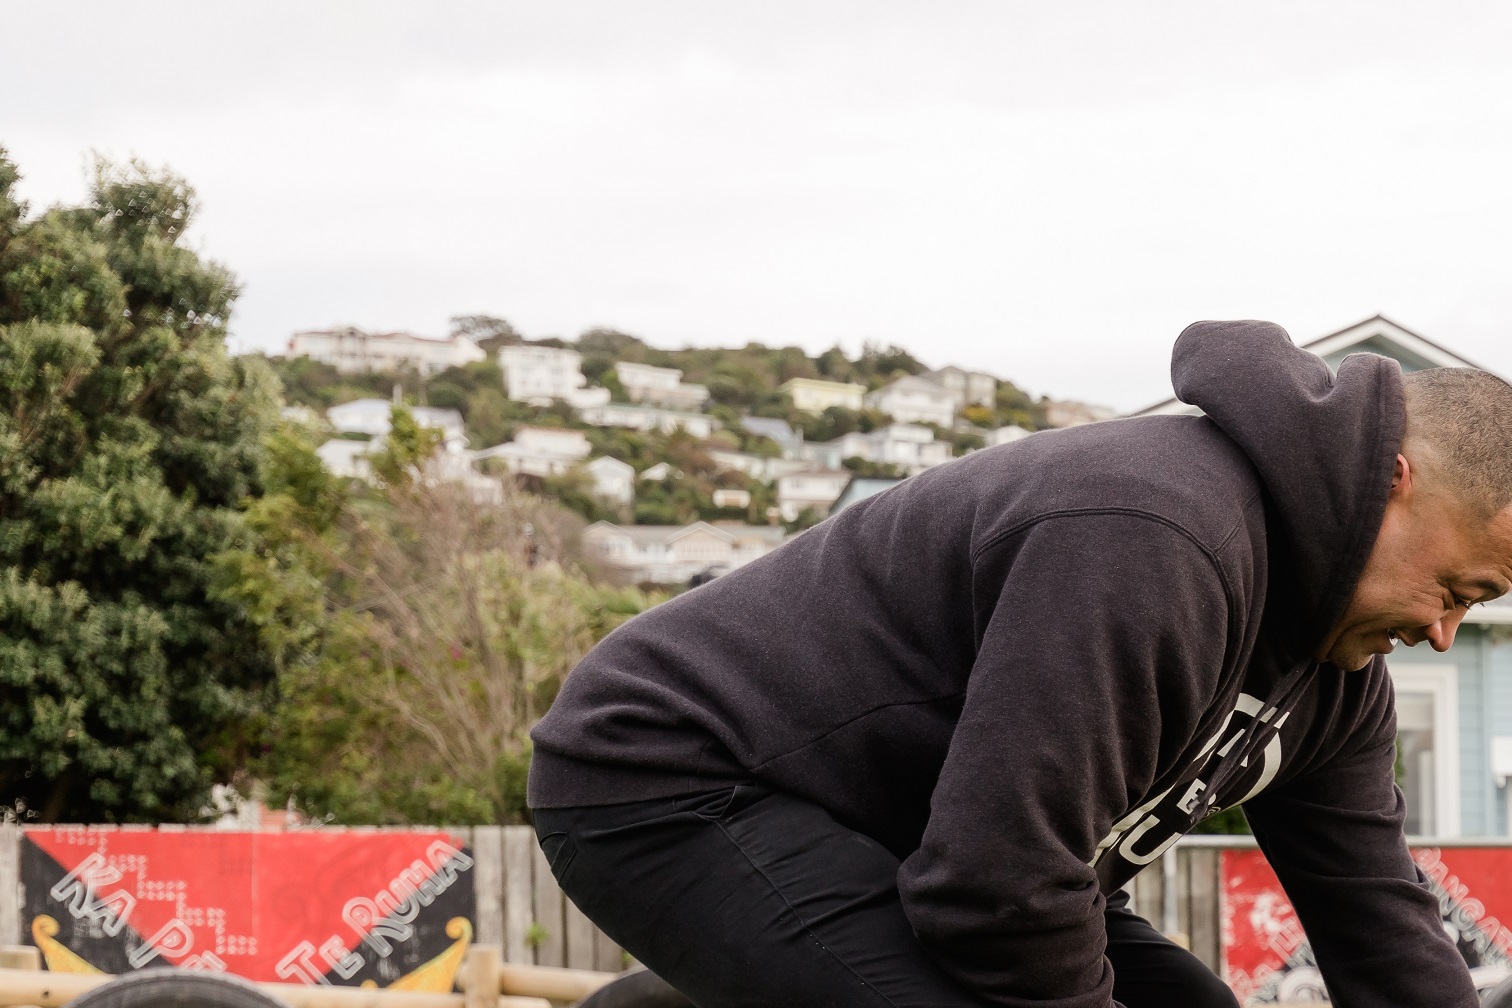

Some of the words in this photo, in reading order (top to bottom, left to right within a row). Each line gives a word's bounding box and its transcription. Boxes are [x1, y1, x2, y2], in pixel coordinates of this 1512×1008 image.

[50, 852, 137, 938] KA
[275, 934, 366, 986] TE
[342, 839, 474, 958] RUHA
